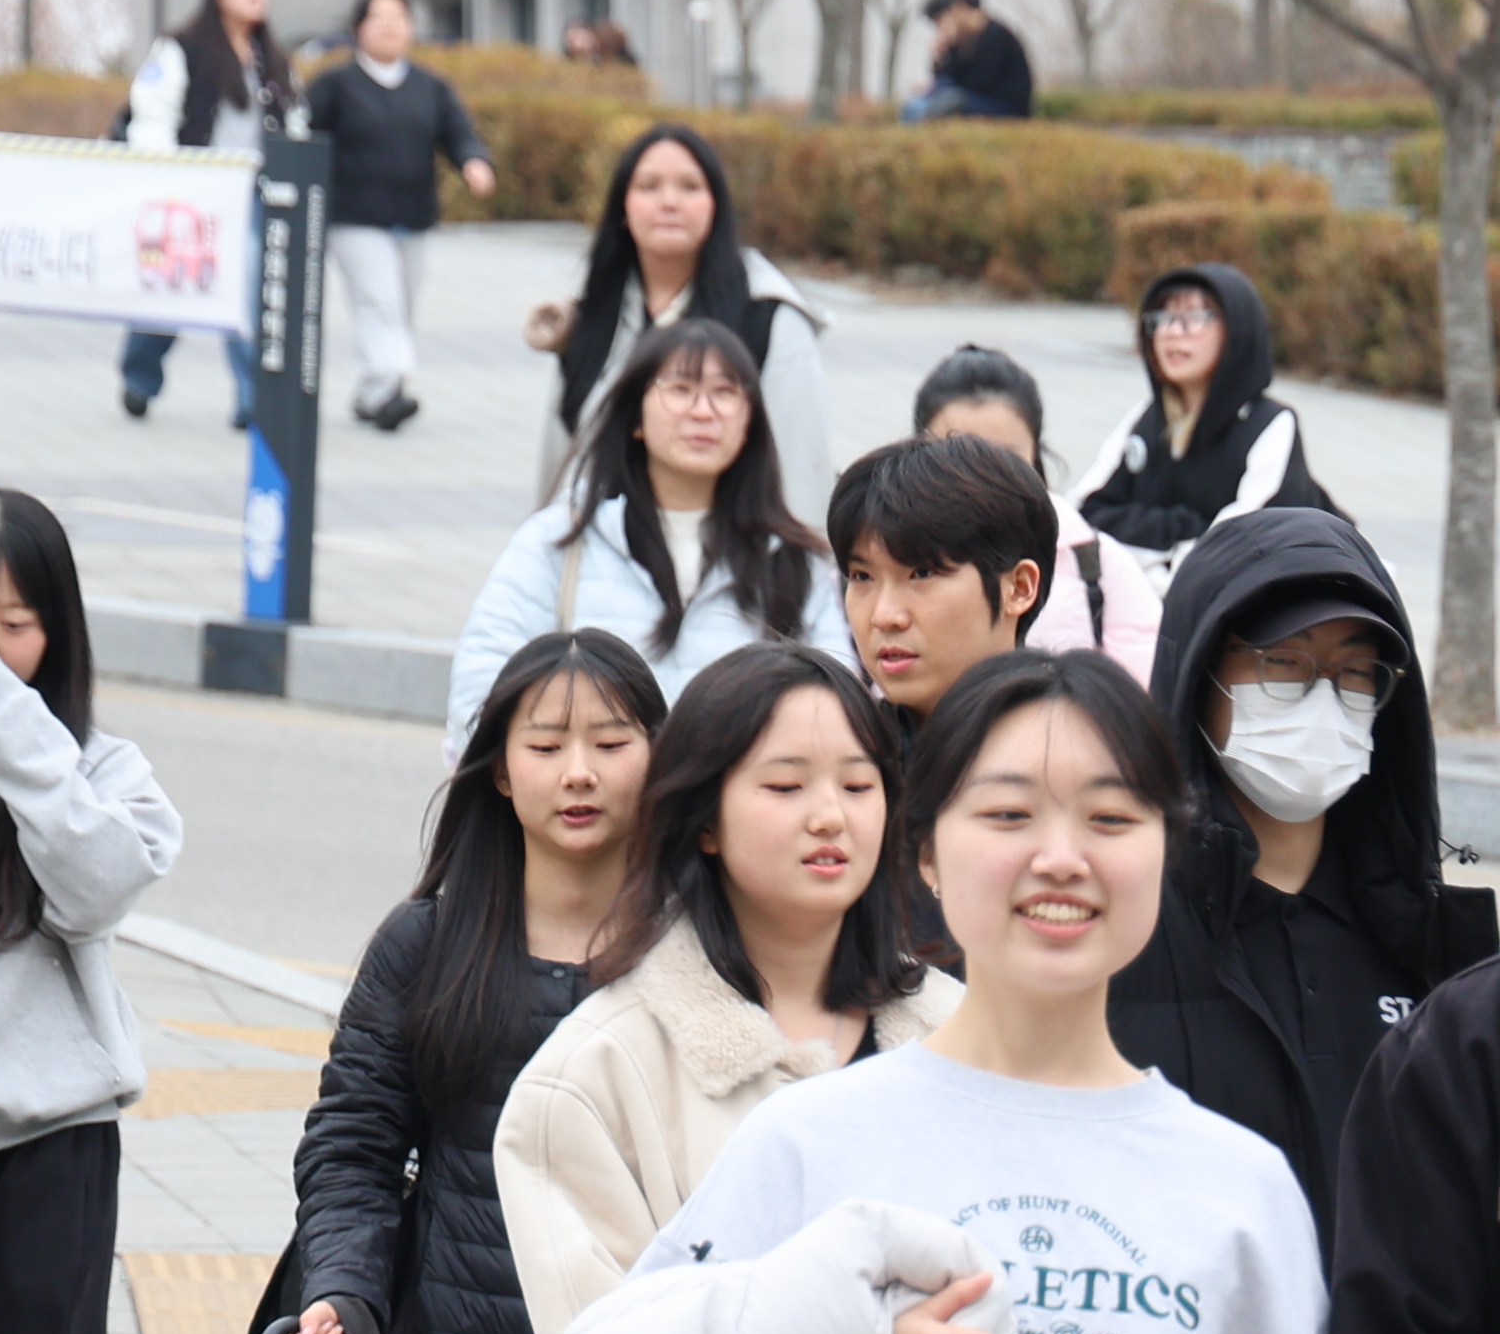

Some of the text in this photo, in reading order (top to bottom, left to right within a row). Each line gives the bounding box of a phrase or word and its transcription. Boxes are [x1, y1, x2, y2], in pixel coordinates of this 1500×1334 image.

[987, 1197, 1011, 1212] OF
[1018, 1195, 1070, 1214] HUNT
[1075, 1205, 1148, 1267] ORIGINAL
